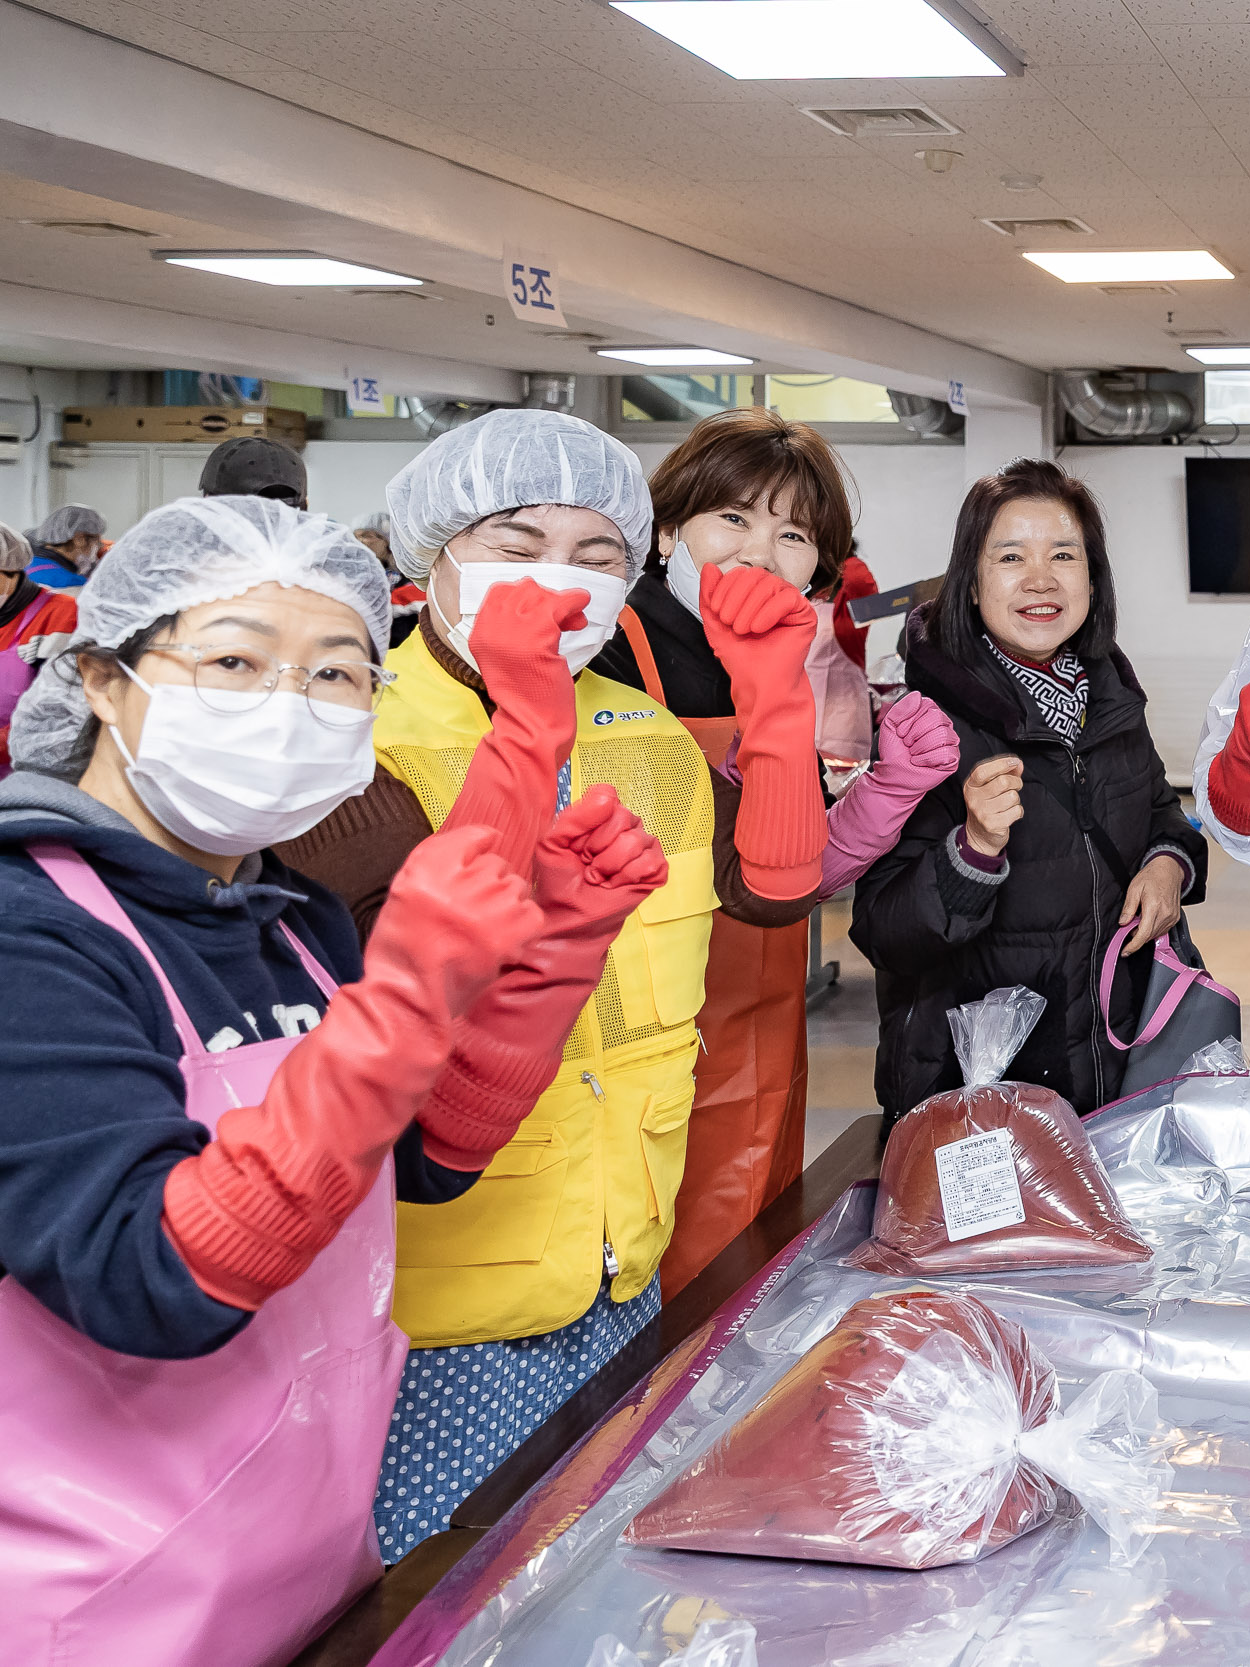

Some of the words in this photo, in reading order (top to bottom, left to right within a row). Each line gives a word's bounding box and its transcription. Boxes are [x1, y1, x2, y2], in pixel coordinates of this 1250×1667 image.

[511, 263, 556, 311] 5조
[352, 377, 379, 403] 1조
[617, 710, 656, 721] 광진구
